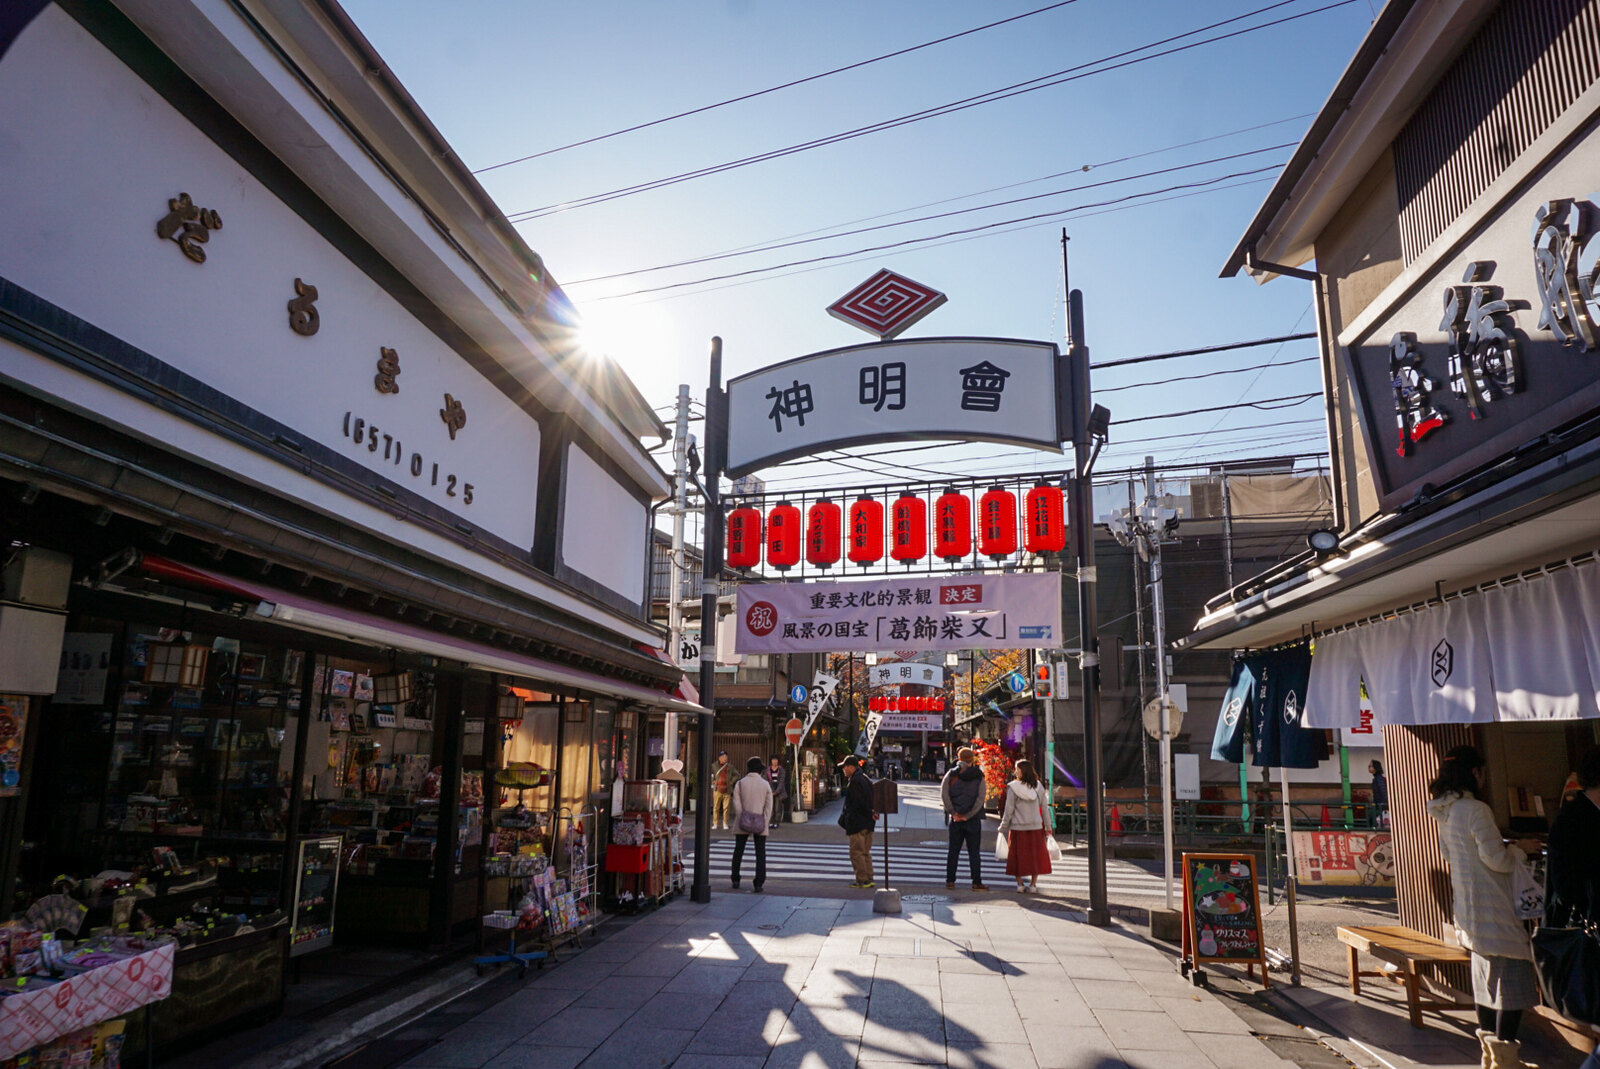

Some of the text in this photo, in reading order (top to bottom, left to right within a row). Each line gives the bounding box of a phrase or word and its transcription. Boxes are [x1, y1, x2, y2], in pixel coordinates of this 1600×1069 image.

[156, 191, 467, 440] だるまや
[765, 360, 1010, 432] 神明會
[1035, 496, 1048, 537] 立花屋
[810, 587, 933, 609] 重要文化的景観
[944, 587, 977, 602] 決定
[750, 606, 773, 629] 祝
[1215, 928, 1249, 939] クリスマス
